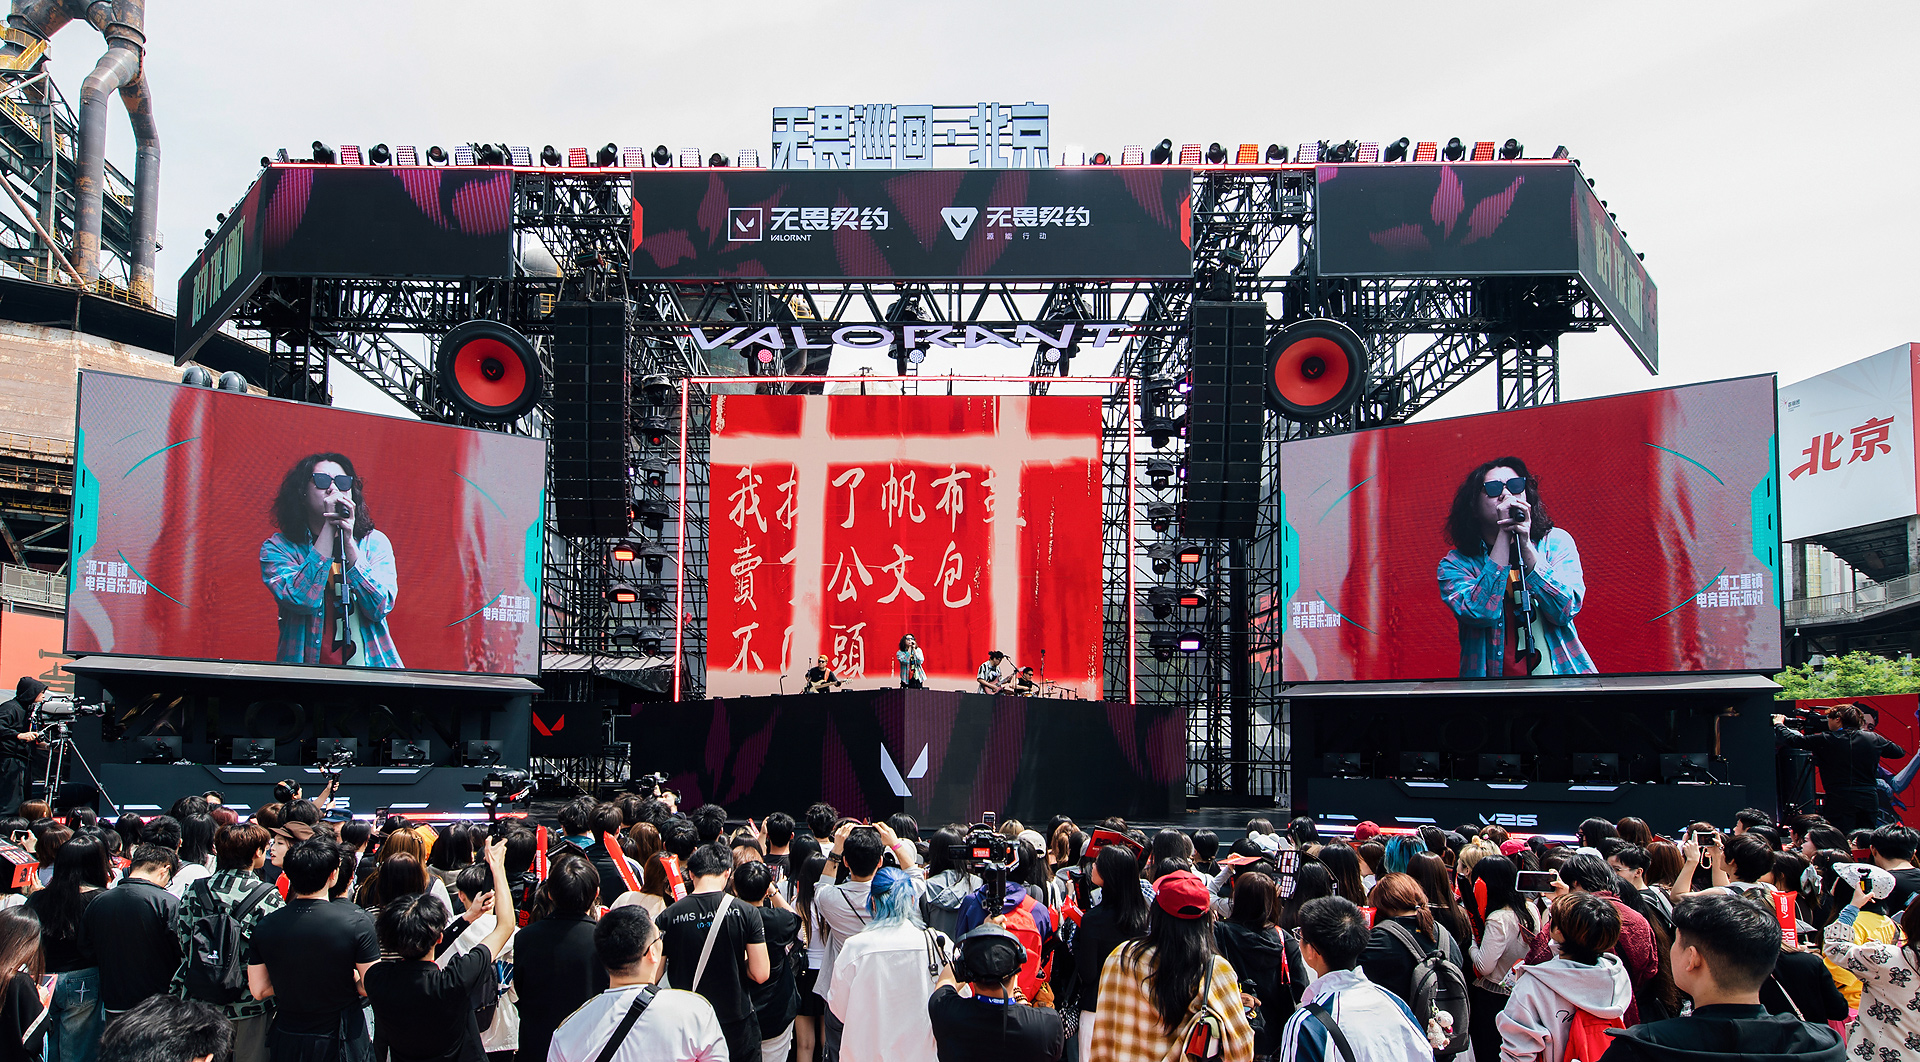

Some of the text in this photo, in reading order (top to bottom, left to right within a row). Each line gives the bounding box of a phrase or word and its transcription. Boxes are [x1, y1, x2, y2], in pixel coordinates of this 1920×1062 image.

[770, 207, 889, 231] 无畏契约
[986, 206, 1090, 228] 无畏契约
[770, 234, 812, 242] VALORANT
[209, 243, 223, 308] THE
[1612, 240, 1627, 311] THE
[689, 323, 1134, 350] VALORANT
[1788, 415, 1894, 481] 北京
[85, 575, 147, 595] 电竞音乐派对
[730, 537, 972, 611] 賣公文包
[1696, 589, 1763, 608] 电竞音乐派对
[727, 622, 866, 680] 不頭
[1479, 813, 1538, 826] V26
[672, 912, 696, 924] HMS
